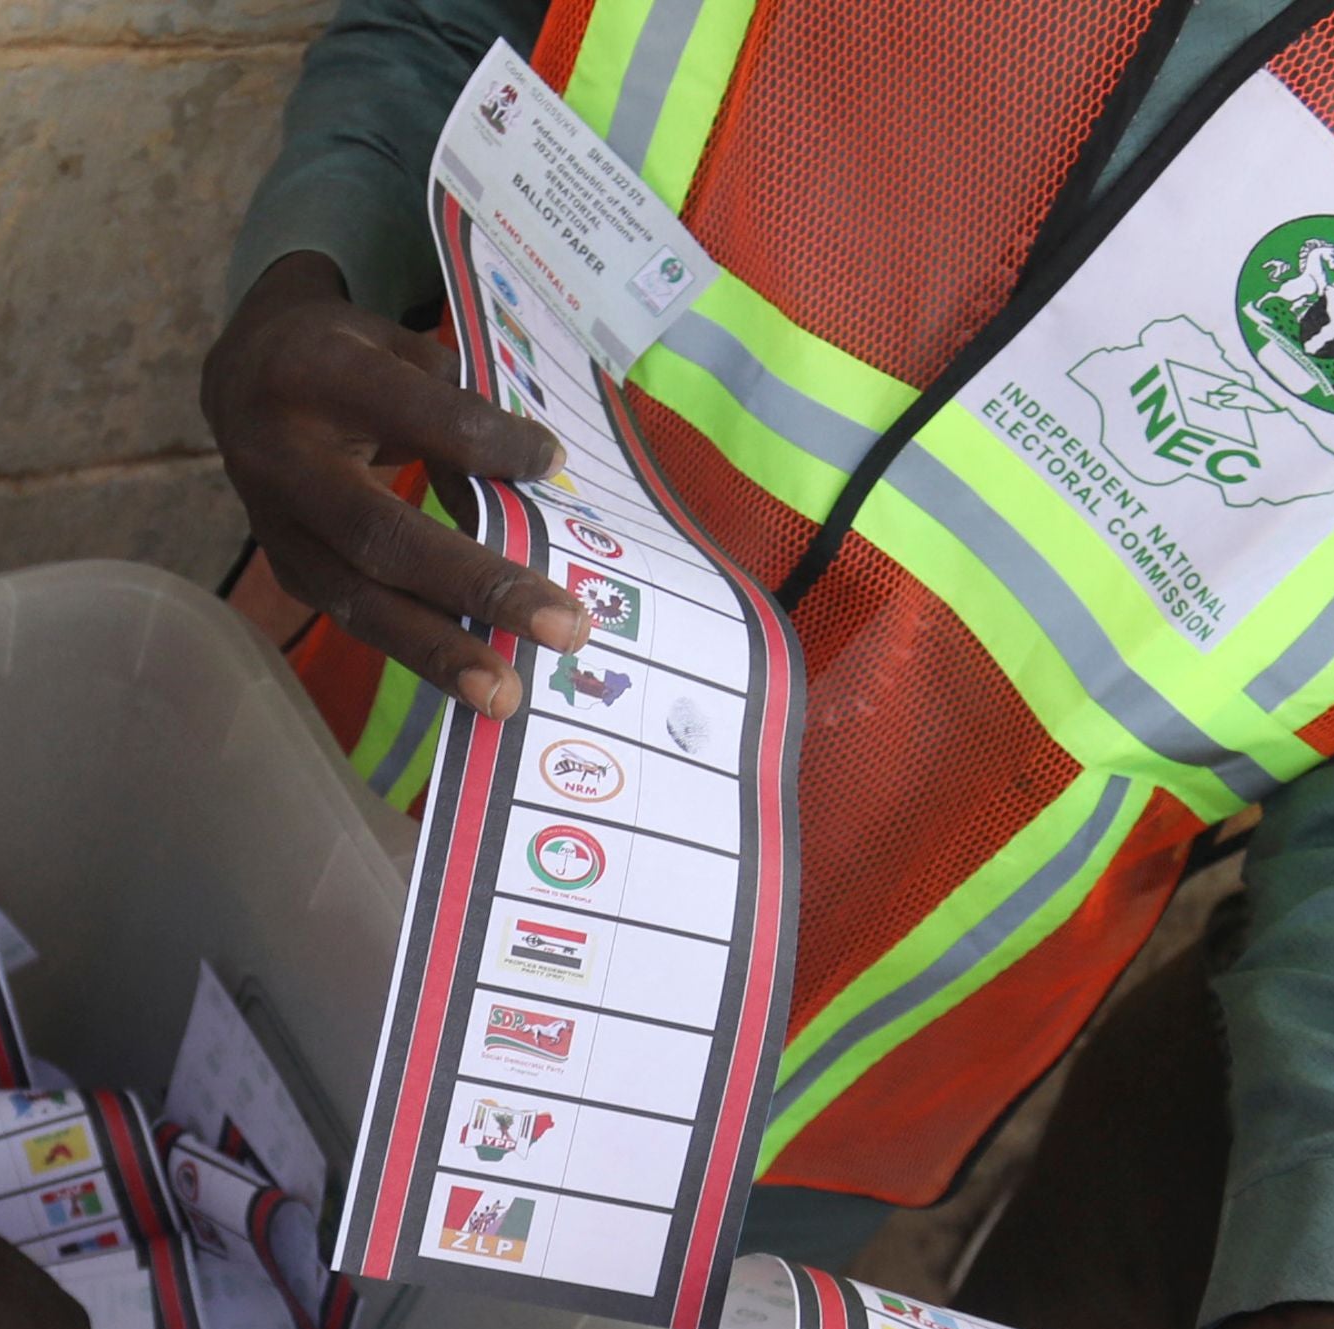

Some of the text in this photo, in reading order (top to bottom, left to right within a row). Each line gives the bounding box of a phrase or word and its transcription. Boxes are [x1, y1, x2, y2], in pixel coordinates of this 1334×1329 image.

[531, 118, 653, 242] Federal Republic of Nigeria
[532, 139, 635, 243] 2023 General Elections
[545, 169, 602, 230] SENATORIAL
[512, 173, 562, 228] BALLOT
[560, 227, 606, 276] PAPER
[545, 188, 590, 235] ELECTION
[493, 209, 523, 245] KANO
[522, 244, 566, 296] CENTRAL
[566, 292, 581, 312] SD
[1129, 364, 1261, 485] INEC
[981, 398, 1216, 644] ELECTORAL COMMISSION
[999, 381, 1228, 622] INDEPENDENT NATIONAL
[564, 781, 598, 796] NRM
[521, 967, 545, 979] PARTY
[538, 964, 585, 979] REDEMPTION
[490, 1008, 524, 1030] SDP
[480, 1052, 566, 1076] Social Democratic Party
[484, 1136, 516, 1149] YPP
[450, 1231, 514, 1256] ZLP
